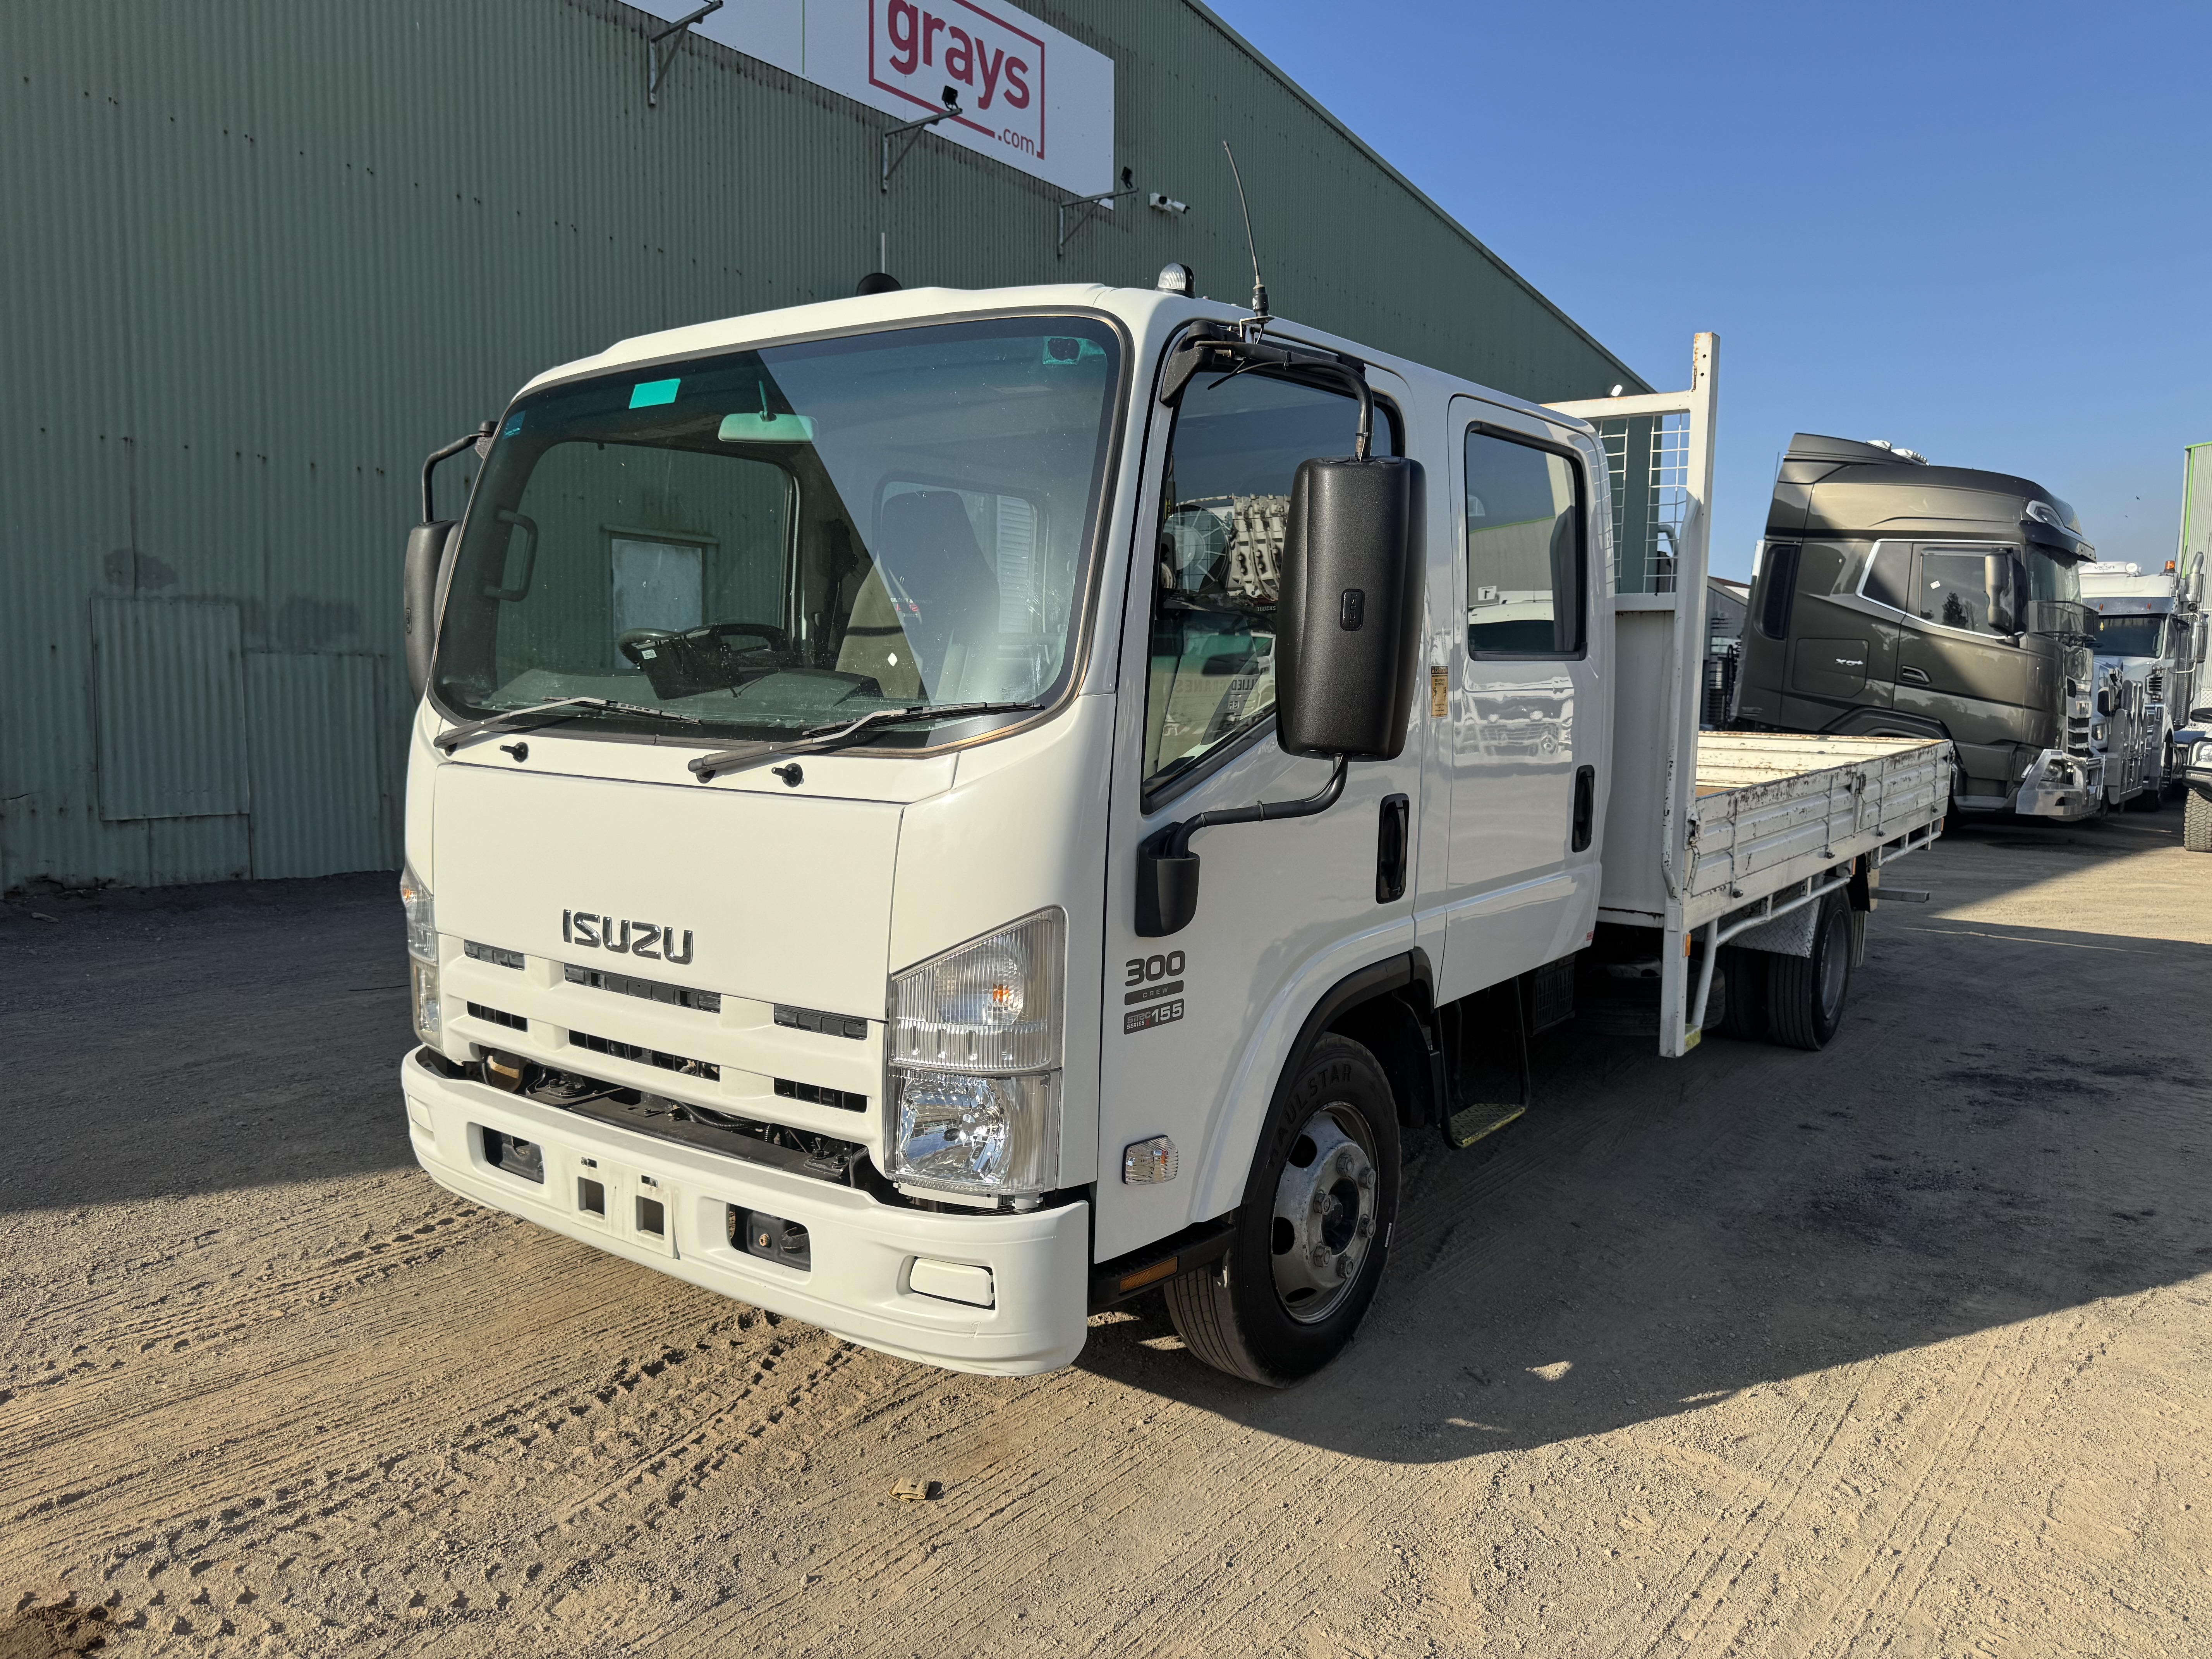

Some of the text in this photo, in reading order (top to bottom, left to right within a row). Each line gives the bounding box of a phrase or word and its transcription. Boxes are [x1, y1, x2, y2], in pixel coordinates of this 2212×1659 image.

[888, 0, 1030, 110] grays
[998, 128, 1034, 156] .com
[1349, 594, 1357, 627] ISUZU
[563, 909, 693, 965] ISUZU
[1125, 950, 1185, 987] 300
[1143, 987, 1168, 998] CREW
[1127, 1020, 1145, 1029] SERIES
[1152, 1002, 1182, 1023] 155
